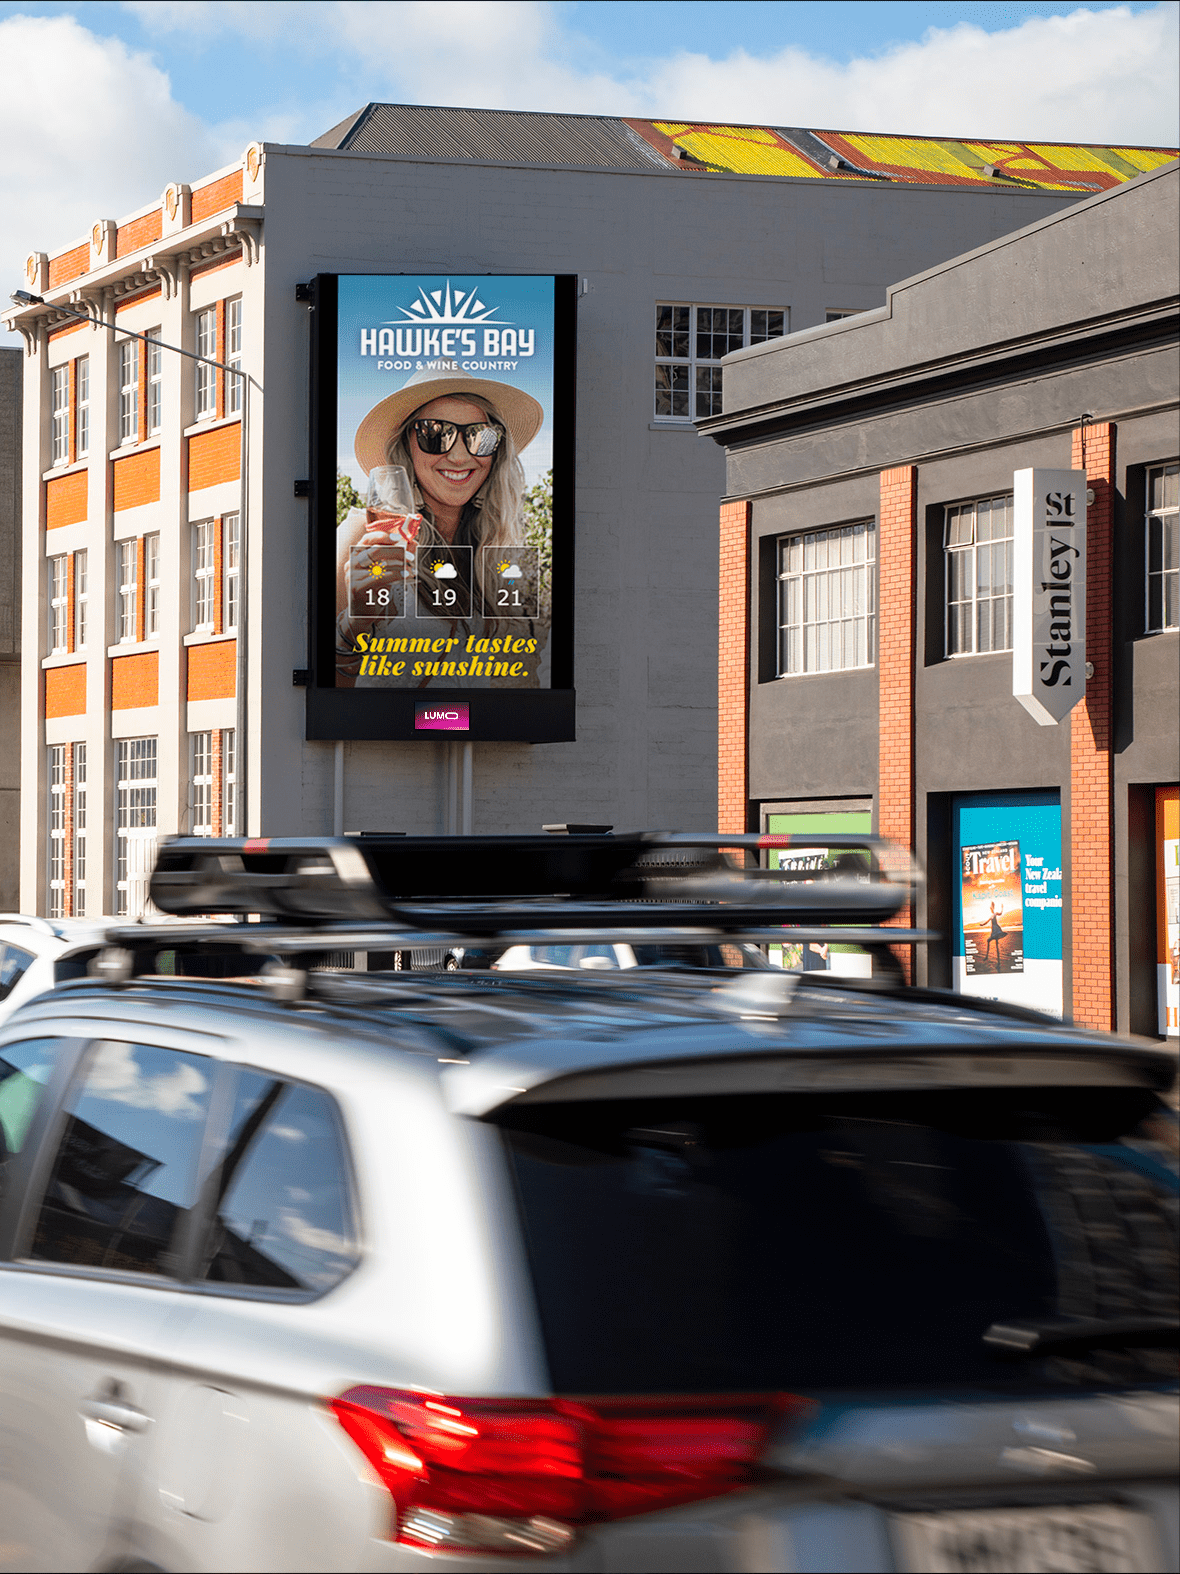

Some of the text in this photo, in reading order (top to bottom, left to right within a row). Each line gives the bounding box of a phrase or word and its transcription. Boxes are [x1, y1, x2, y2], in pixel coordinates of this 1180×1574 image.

[360, 328, 535, 356] HAWKE'S BAY
[377, 360, 518, 371] FOOD & WINE COUNTRY
[365, 588, 390, 606] 18
[432, 589, 457, 606] 19
[497, 589, 522, 606] 21
[1040, 492, 1080, 688] Stanley St
[352, 632, 538, 654] Summer tastes
[358, 654, 529, 677] like sunshine.
[424, 711, 459, 720] LUMO
[969, 848, 1017, 875] Travel
[1025, 854, 1044, 867] Your
[1025, 867, 1041, 880] New
[1025, 881, 1047, 894] travel
